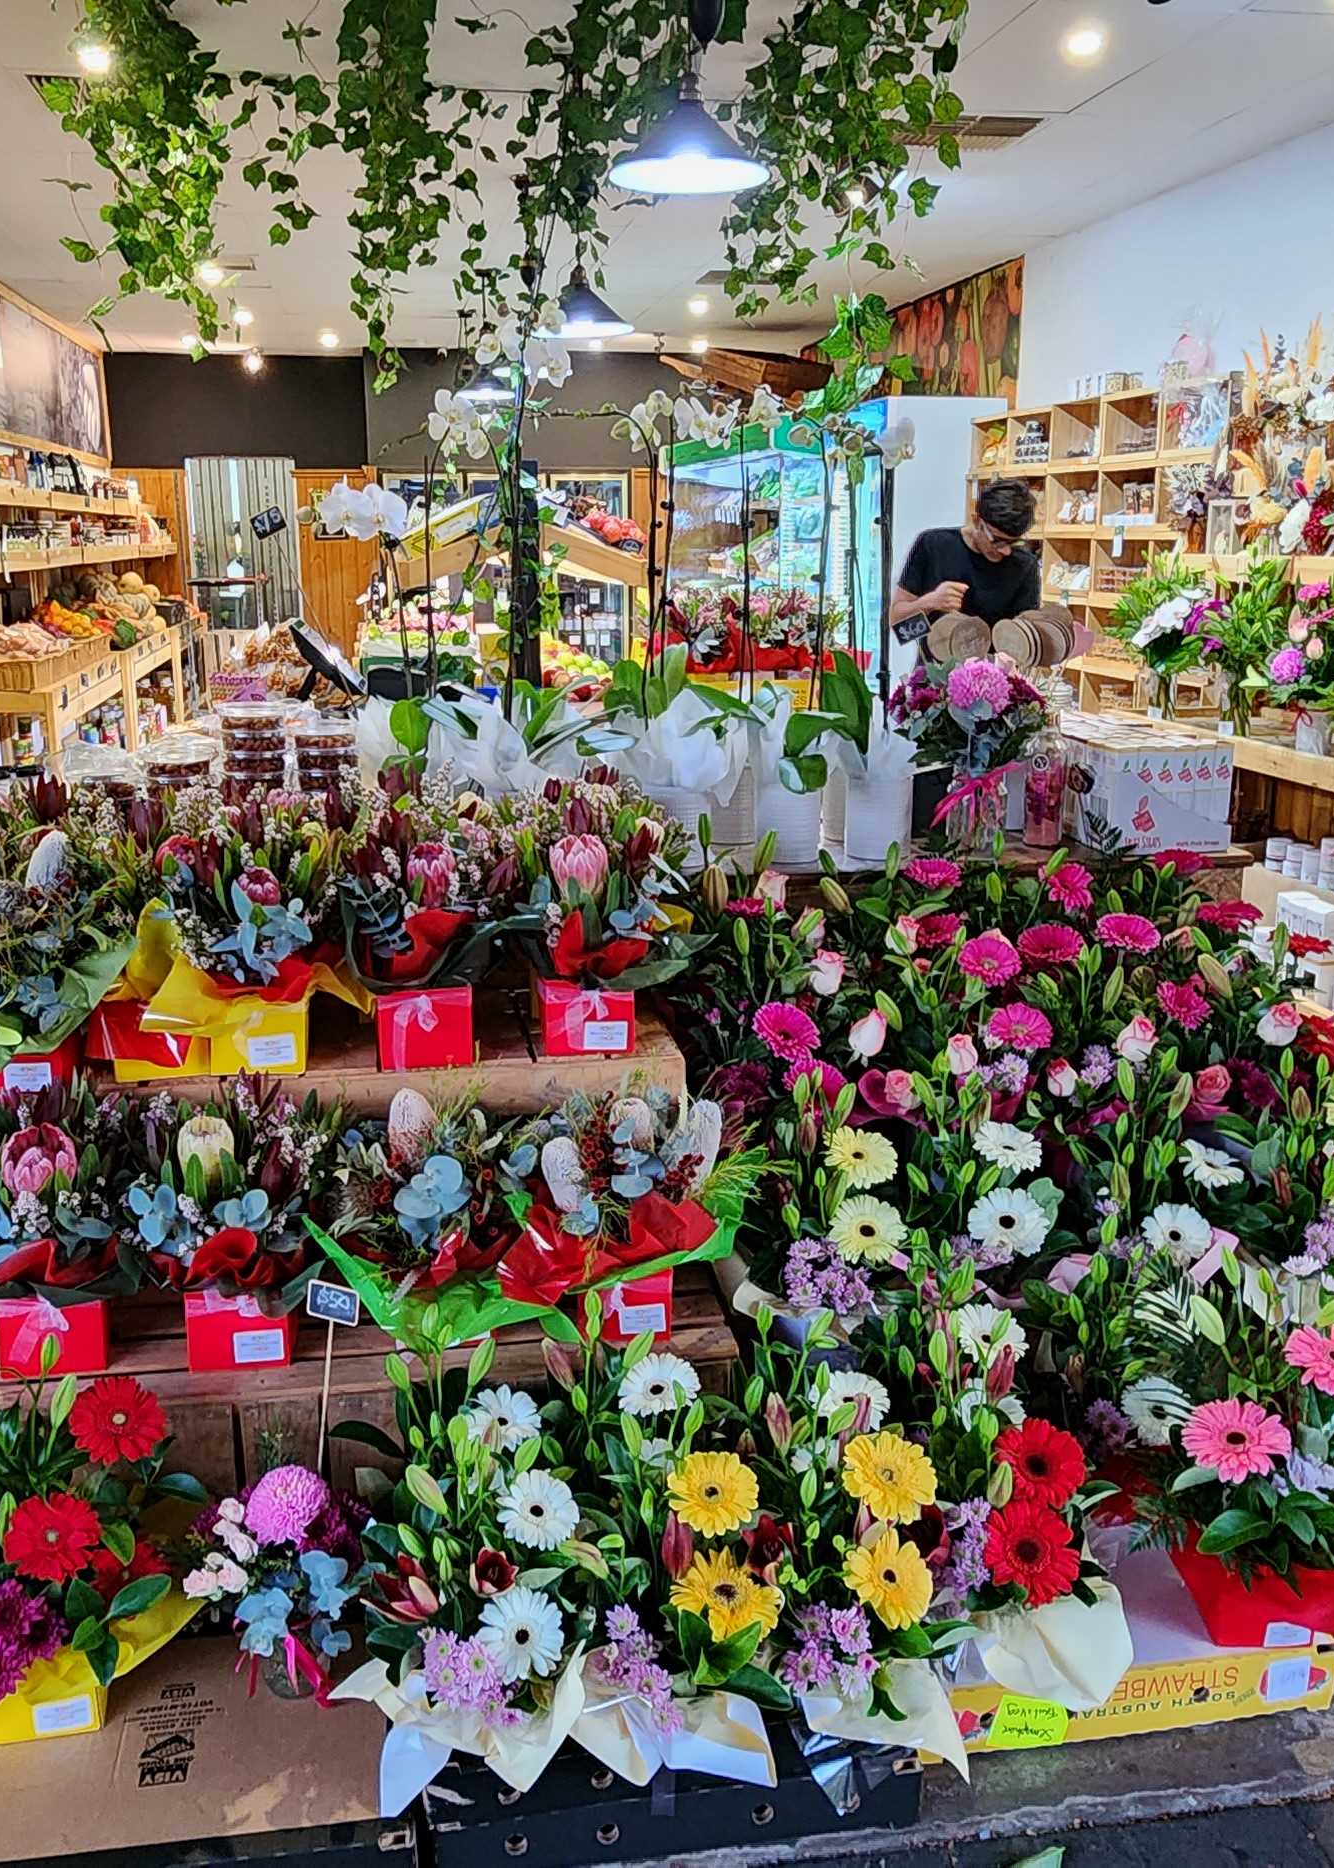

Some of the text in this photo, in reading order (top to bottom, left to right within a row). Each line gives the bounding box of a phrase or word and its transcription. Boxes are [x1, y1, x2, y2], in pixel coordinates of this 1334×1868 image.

[316, 1286, 351, 1313] $50
[1171, 1690, 1237, 1708] SOTH
[141, 1769, 185, 1785] VISY
